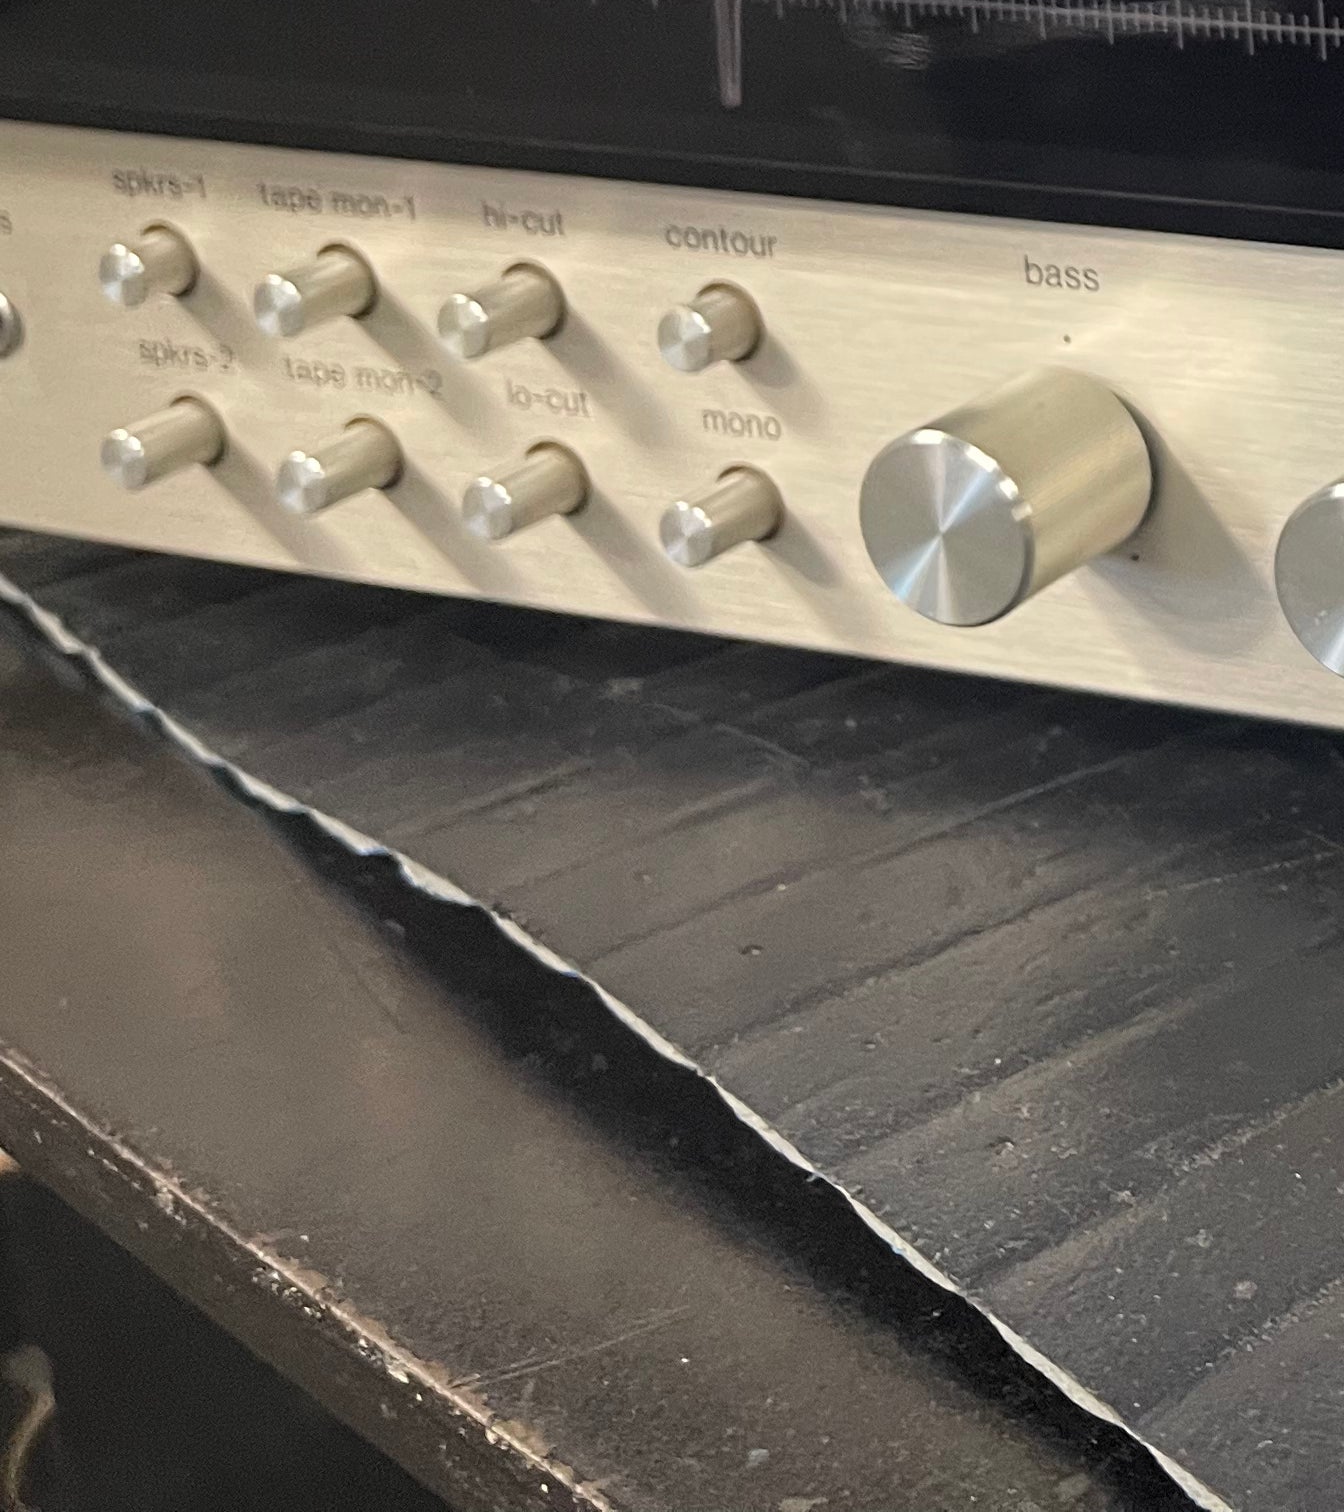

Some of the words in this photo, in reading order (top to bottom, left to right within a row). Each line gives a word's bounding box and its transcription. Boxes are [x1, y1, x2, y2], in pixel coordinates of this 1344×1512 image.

[111, 167, 207, 200] spkrs-1
[256, 182, 322, 215] tape
[330, 190, 417, 221] mon-1
[481, 201, 566, 237] hi-cut
[665, 225, 779, 258] contour
[1024, 255, 1100, 292] bass
[282, 356, 347, 390] tape
[354, 366, 445, 402] mon-2
[506, 379, 592, 418] lo-cut
[702, 408, 783, 440] mono
